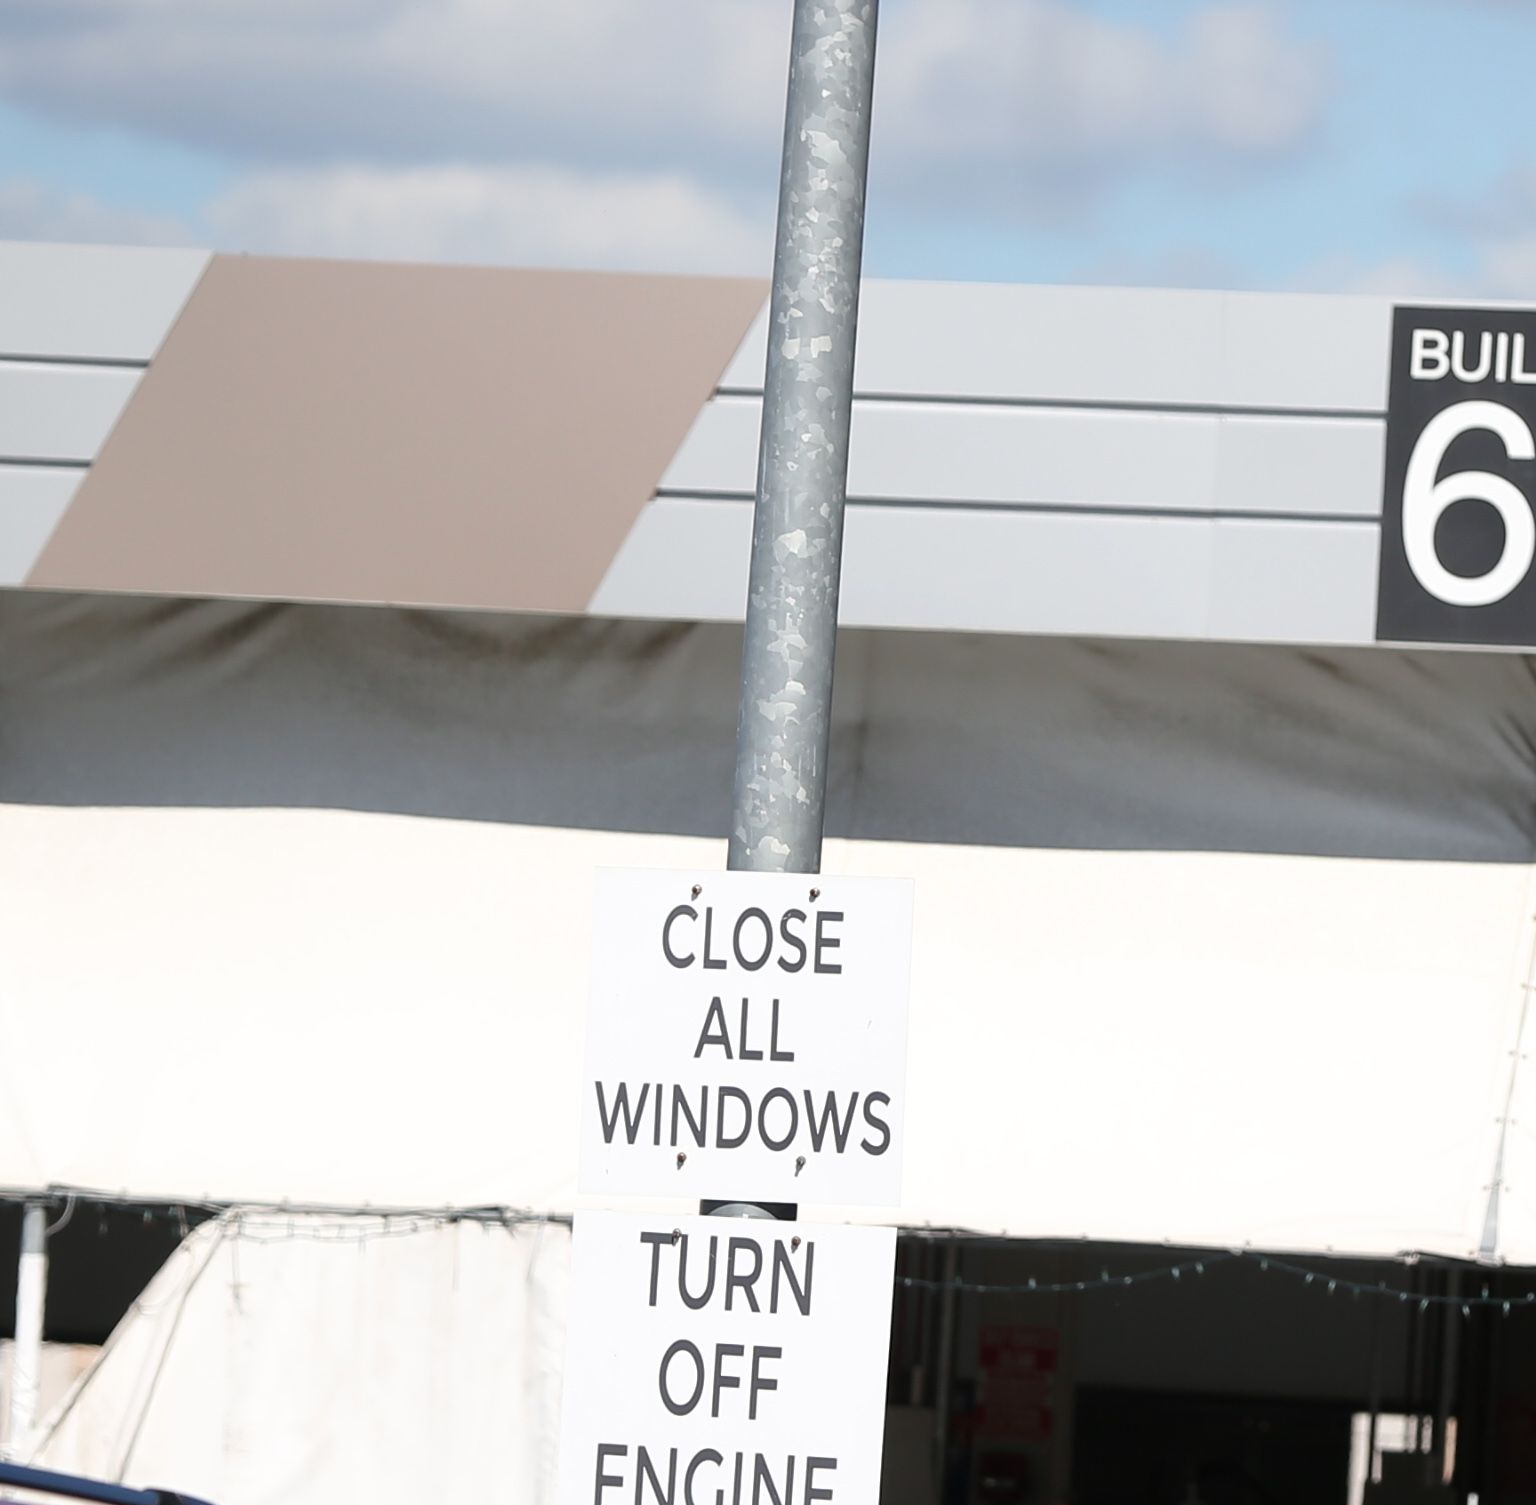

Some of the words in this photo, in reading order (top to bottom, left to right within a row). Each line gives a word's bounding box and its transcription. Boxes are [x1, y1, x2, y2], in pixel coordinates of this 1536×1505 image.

[662, 904, 844, 974] CLOSE
[693, 996, 795, 1062] ALL
[595, 1080, 891, 1156] WINDOWS
[640, 1231, 814, 1316] TURN
[658, 1338, 782, 1420] OFF
